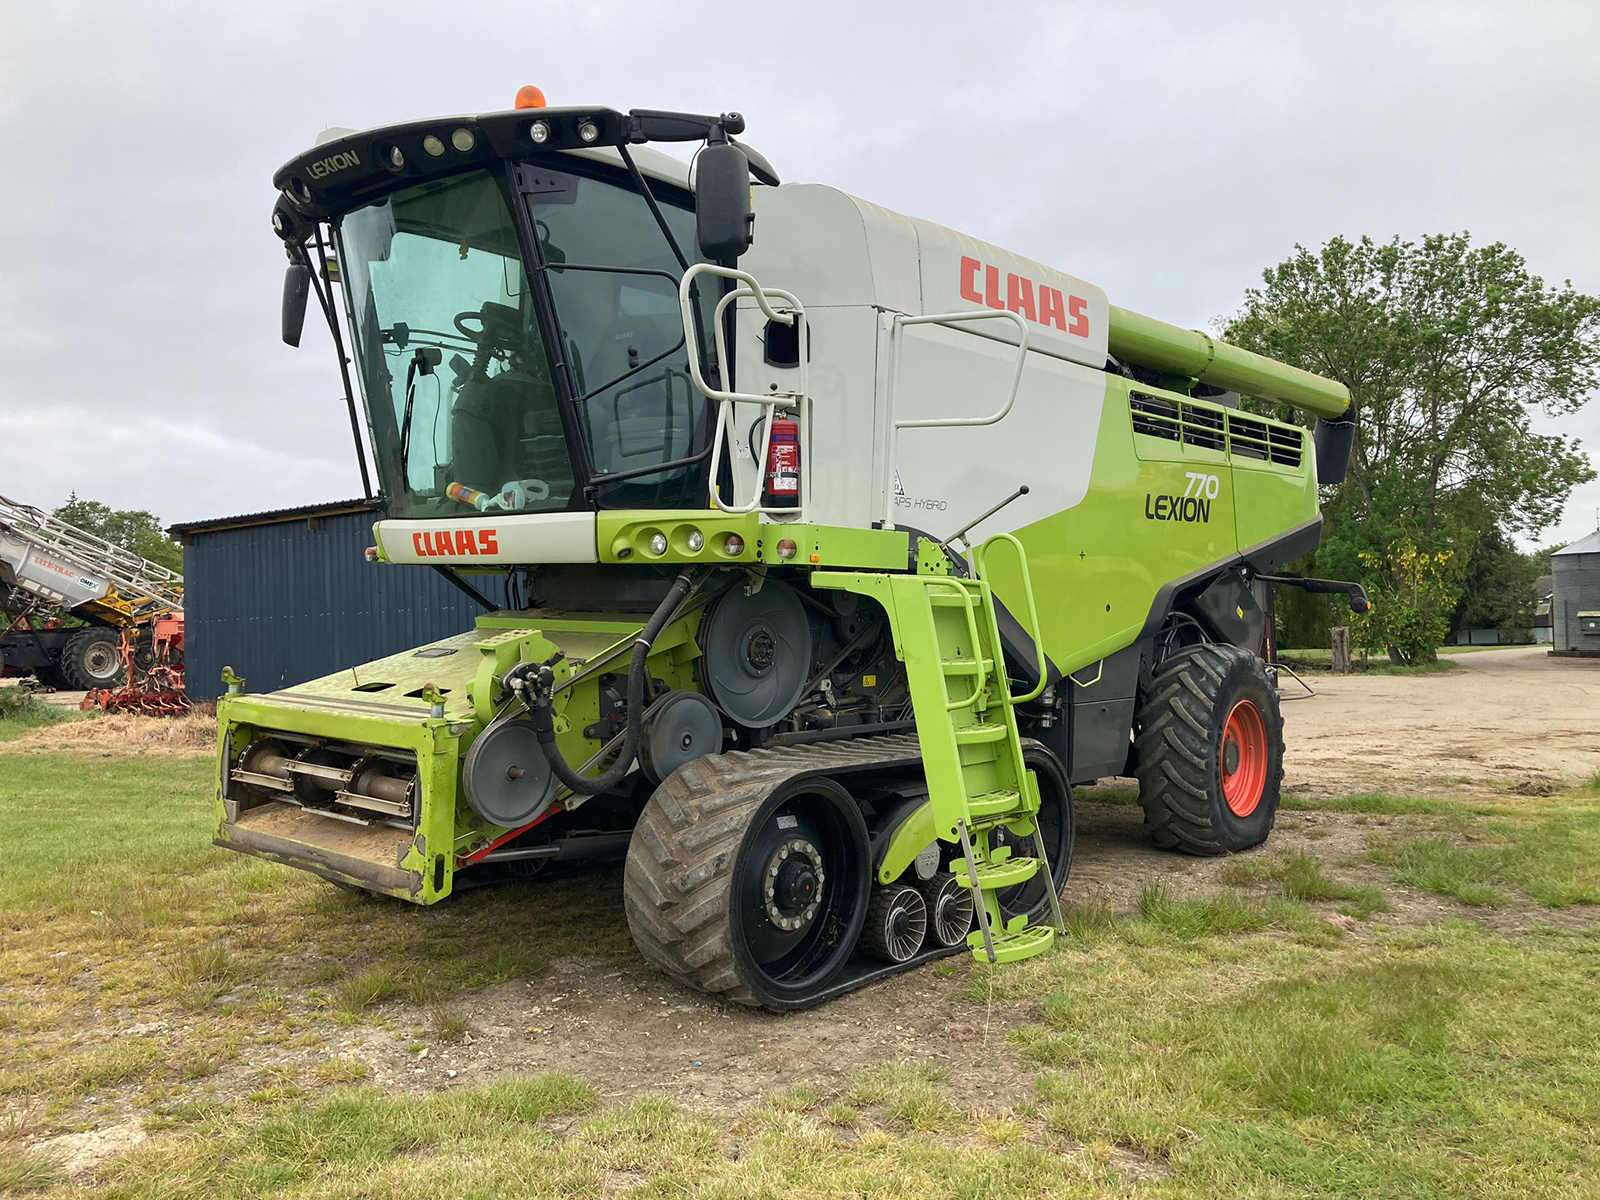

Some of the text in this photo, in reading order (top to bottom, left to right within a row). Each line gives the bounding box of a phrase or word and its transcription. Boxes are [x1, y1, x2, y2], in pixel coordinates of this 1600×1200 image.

[305, 150, 361, 180] LEXION
[960, 255, 1089, 338] CLAAS
[1184, 471, 1220, 499] 770
[913, 498, 948, 511] HYBRID
[1145, 493, 1211, 523] LEXION
[412, 529, 499, 556] CLAAS
[79, 577, 99, 589] OMEX
